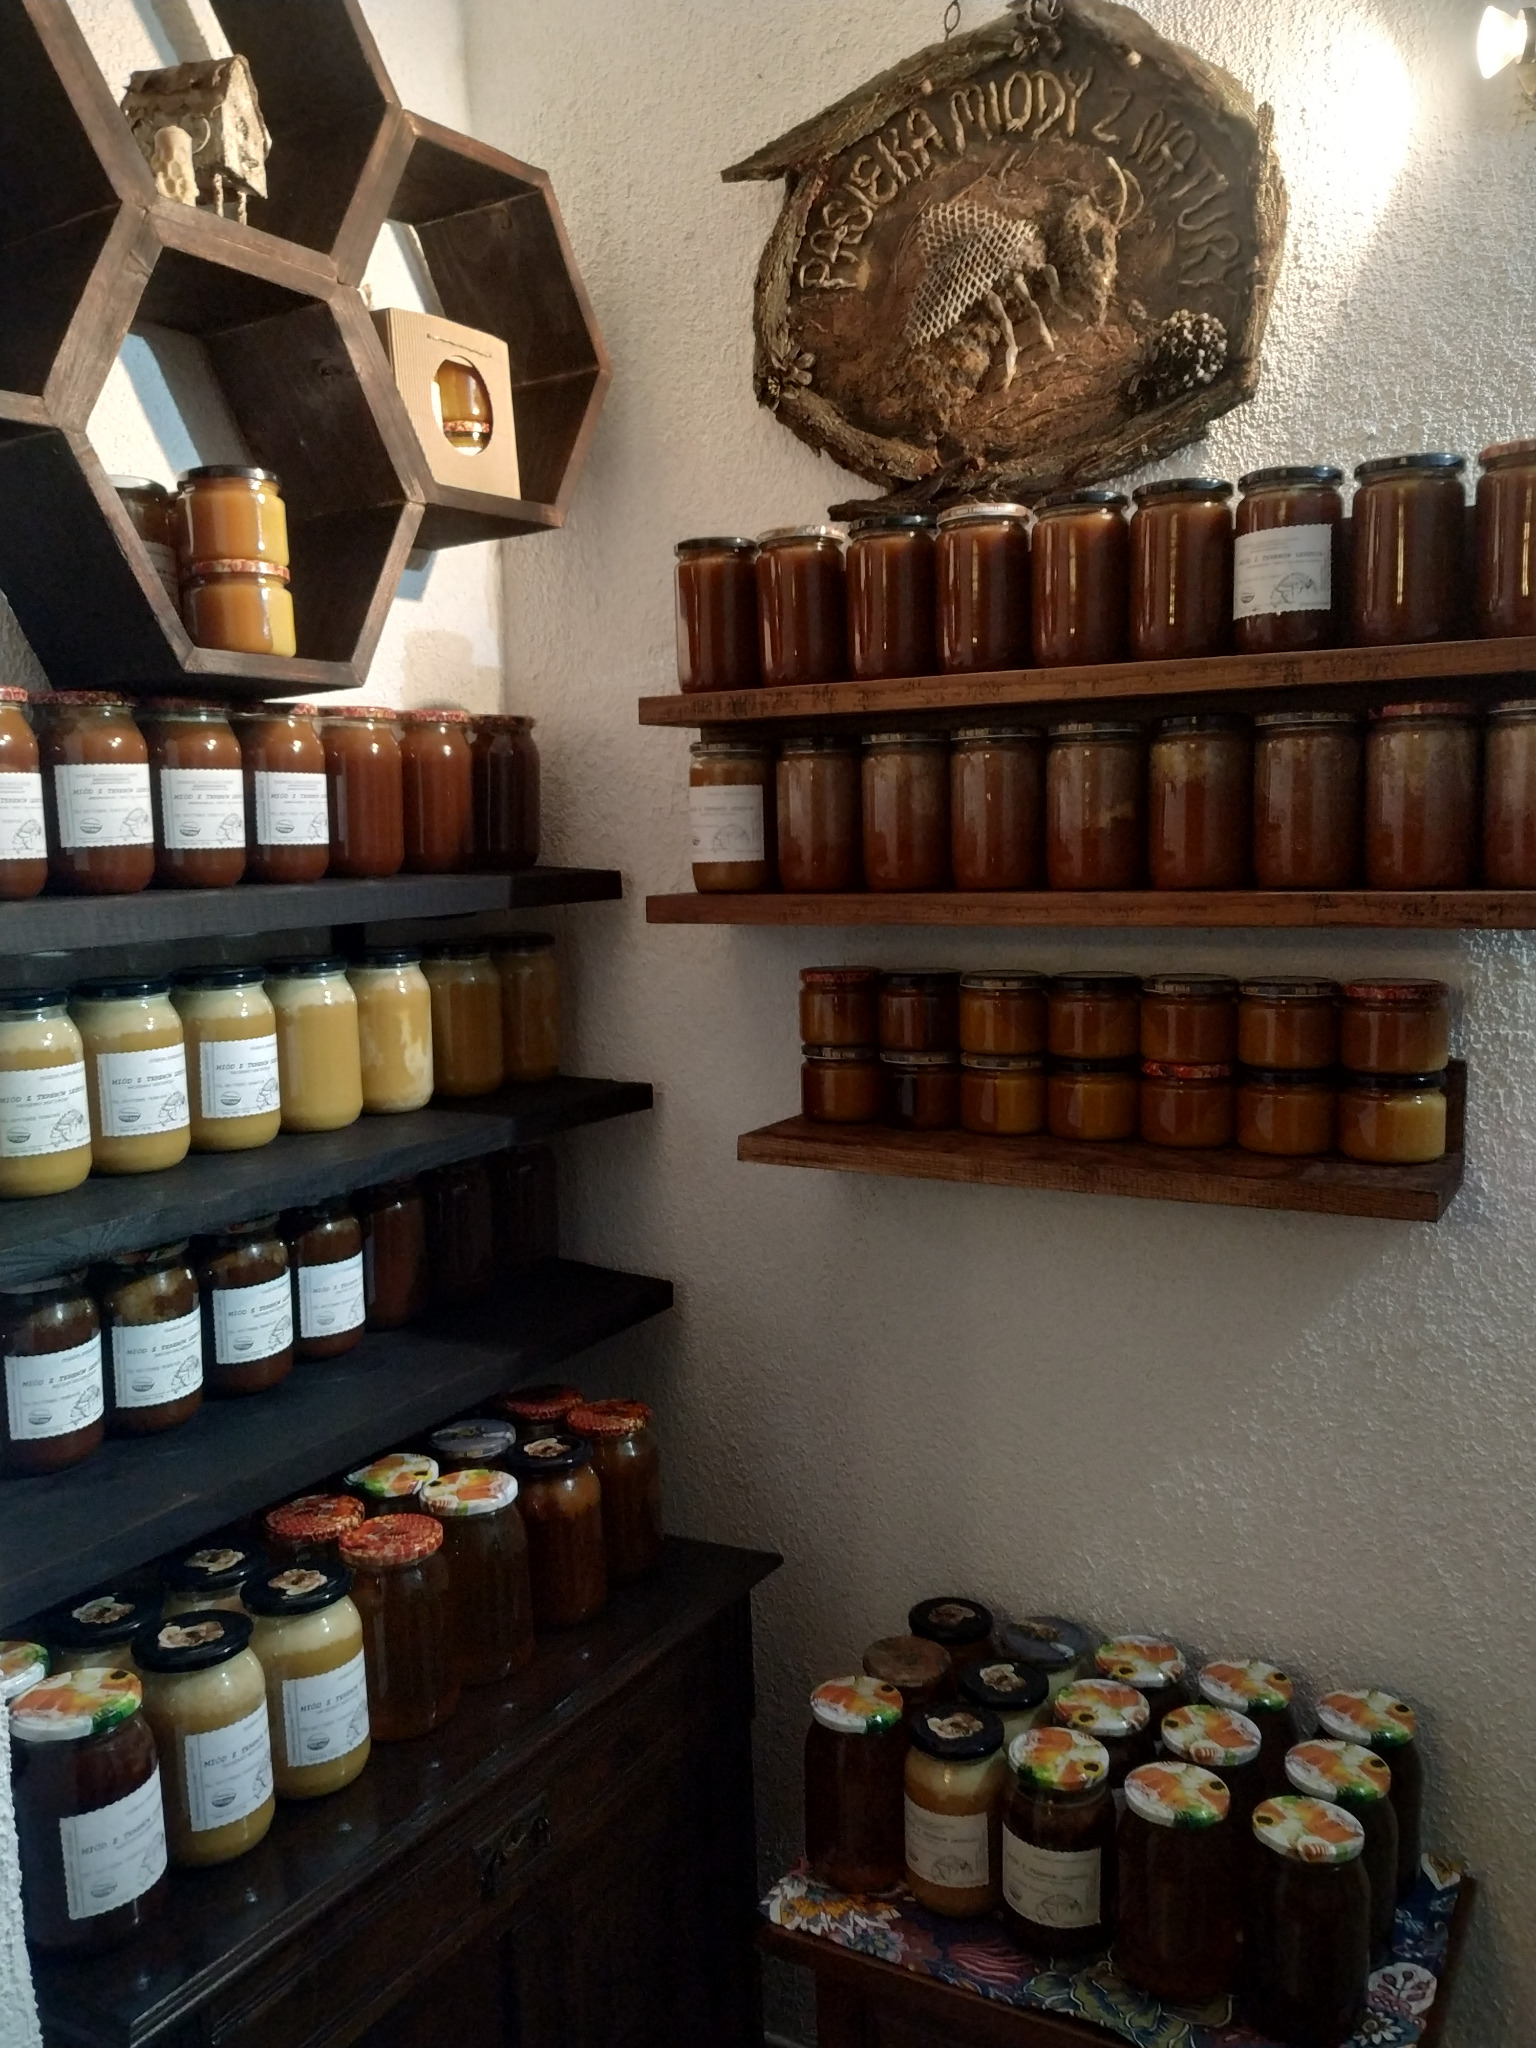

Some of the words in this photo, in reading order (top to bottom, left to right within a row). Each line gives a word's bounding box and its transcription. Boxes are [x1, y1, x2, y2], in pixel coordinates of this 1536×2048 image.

[799, 106, 945, 289] PASIEKA
[950, 67, 1094, 153] MIODY
[1092, 87, 1134, 143] Z
[1129, 106, 1240, 287] NATURY
